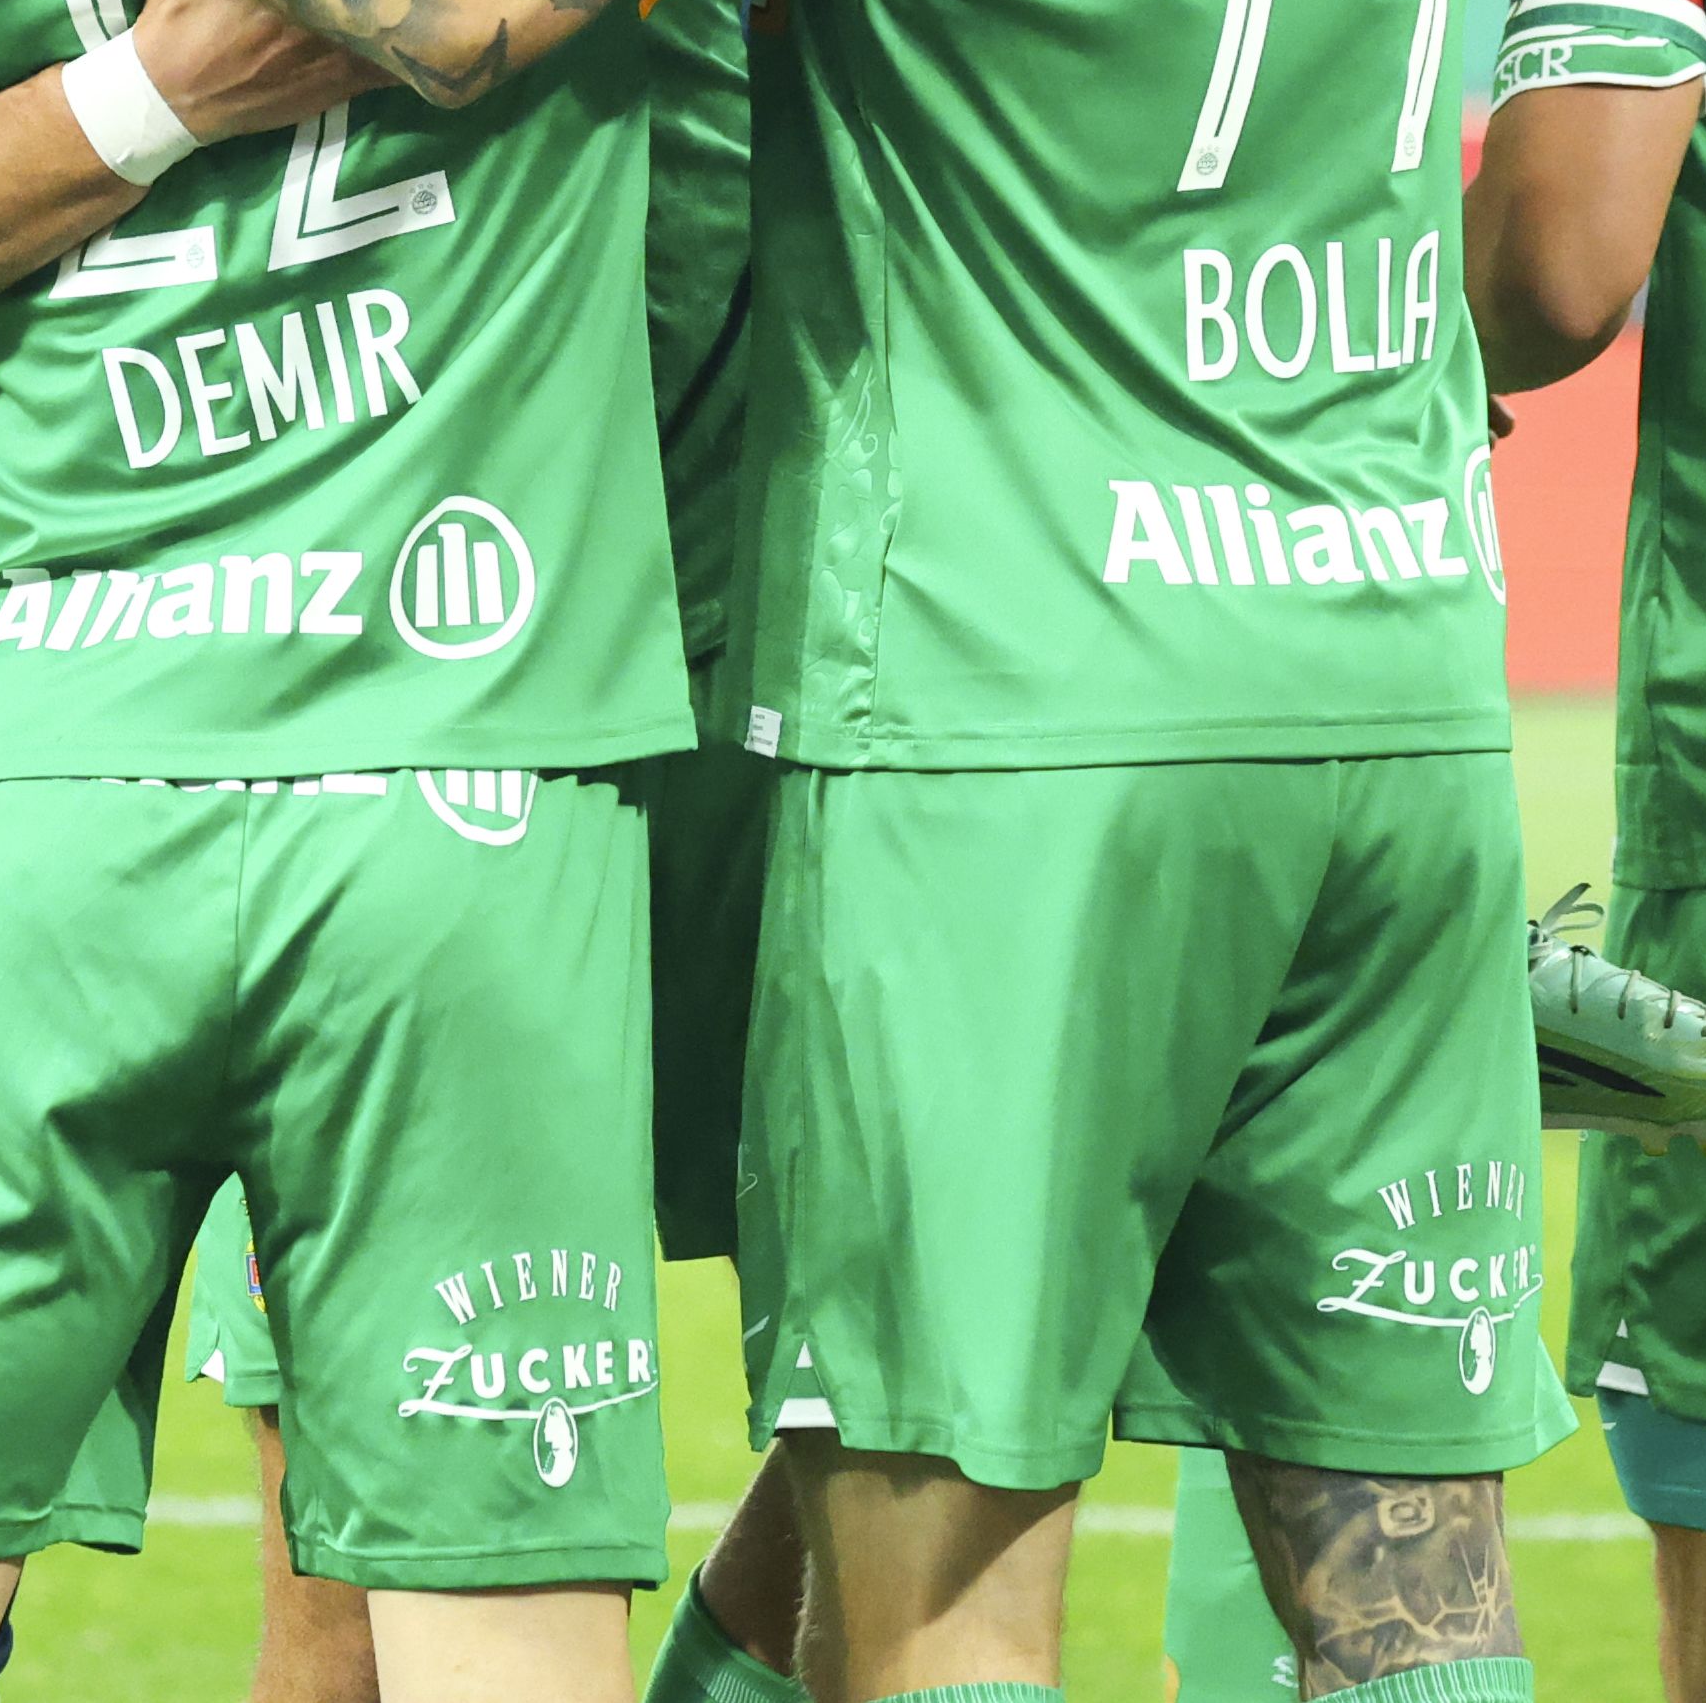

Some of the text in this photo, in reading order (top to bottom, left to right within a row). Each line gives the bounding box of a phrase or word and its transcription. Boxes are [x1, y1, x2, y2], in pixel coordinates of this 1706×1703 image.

[1497, 44, 1573, 96] SCR
[1183, 230, 1440, 382] BOLLA
[102, 287, 423, 470] DEMIR
[1102, 479, 1470, 587] Allianz
[434, 1248, 622, 1325] WIENER
[397, 1338, 654, 1419] ZUCKER
